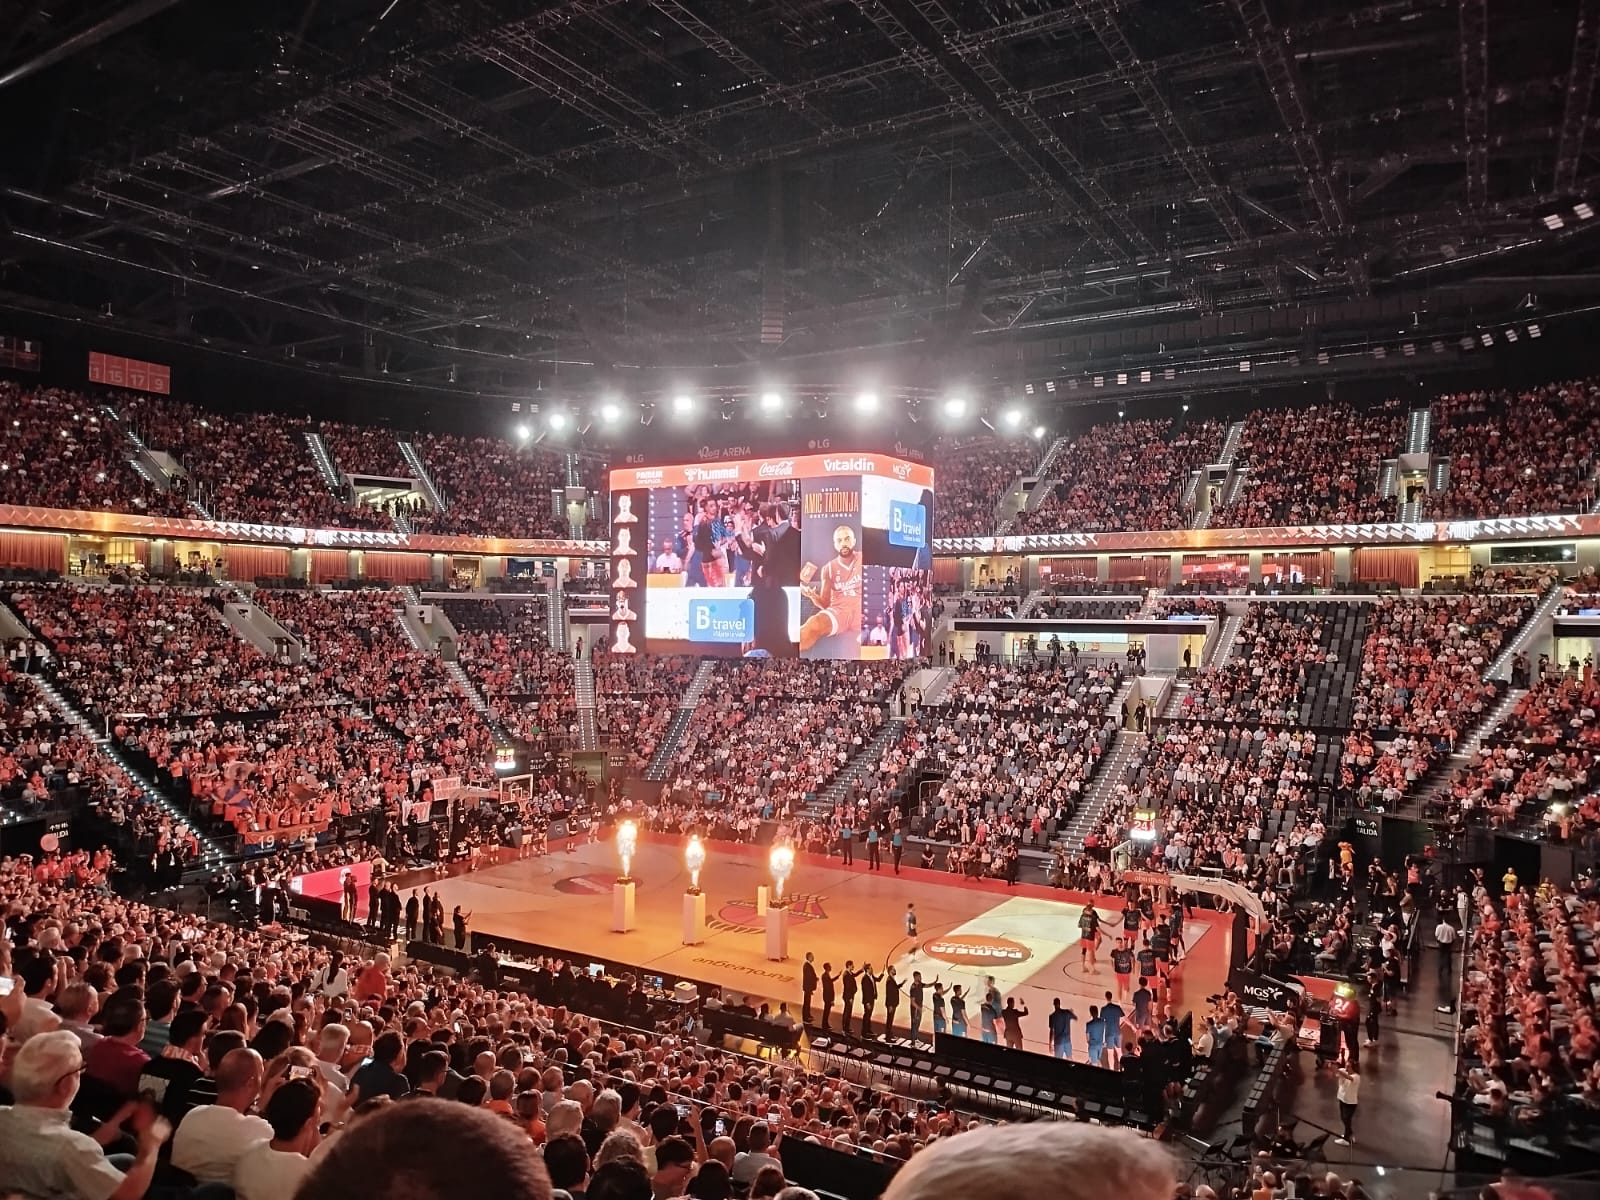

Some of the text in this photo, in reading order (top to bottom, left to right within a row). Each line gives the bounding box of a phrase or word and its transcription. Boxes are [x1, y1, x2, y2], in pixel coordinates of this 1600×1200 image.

[108, 370, 122, 383] 15
[130, 374, 145, 387] 17
[154, 379, 163, 391] 9
[817, 439, 830, 449] LG
[723, 446, 751, 457] ARENA
[633, 454, 644, 463] LG
[698, 465, 739, 481] hummel
[804, 491, 859, 514] AMIC TARONJA
[903, 523, 921, 536] travel
[696, 605, 746, 631] B travel
[930, 945, 1023, 959] PAMESA
[692, 957, 796, 983] EuroLeague
[1243, 985, 1269, 998] MGS
